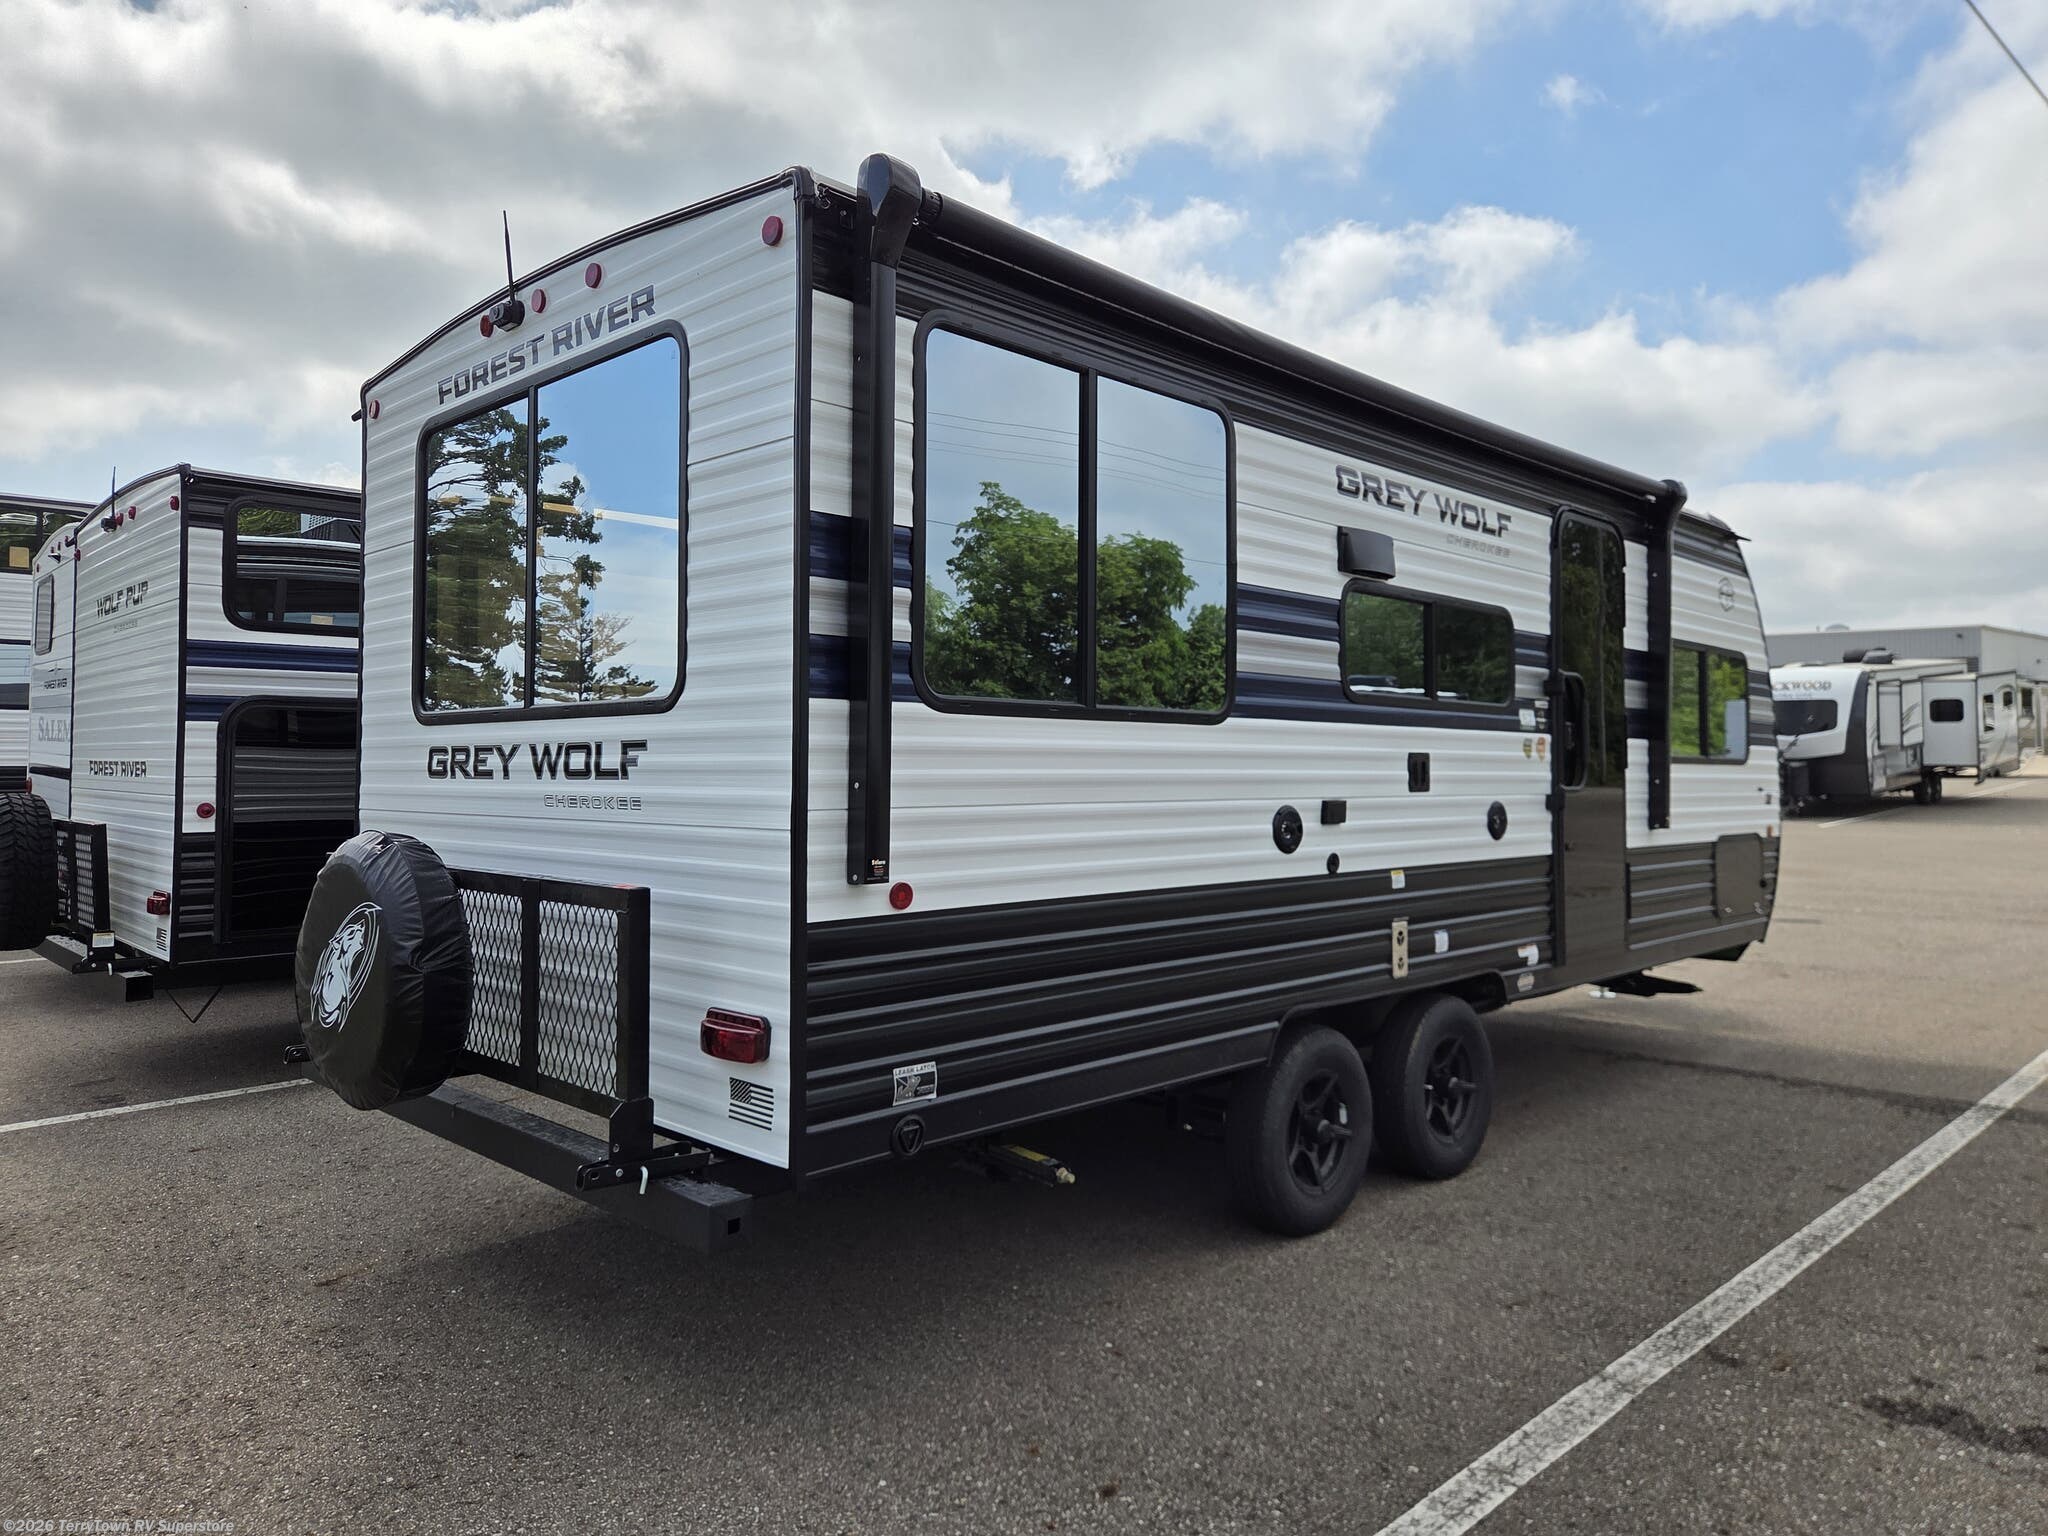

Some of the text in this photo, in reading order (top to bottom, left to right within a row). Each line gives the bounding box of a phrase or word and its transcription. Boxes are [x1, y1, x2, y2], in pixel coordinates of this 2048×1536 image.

[437, 284, 656, 406] FOREST RIVER
[1335, 464, 1512, 538] GREY WOLF
[1445, 533, 1511, 559] CHEROKEE
[96, 580, 149, 619] WOLF PUP
[88, 760, 147, 778] FOREST RIVER
[427, 739, 648, 781] GREY WOLF
[543, 794, 642, 811] CHEROKEE
